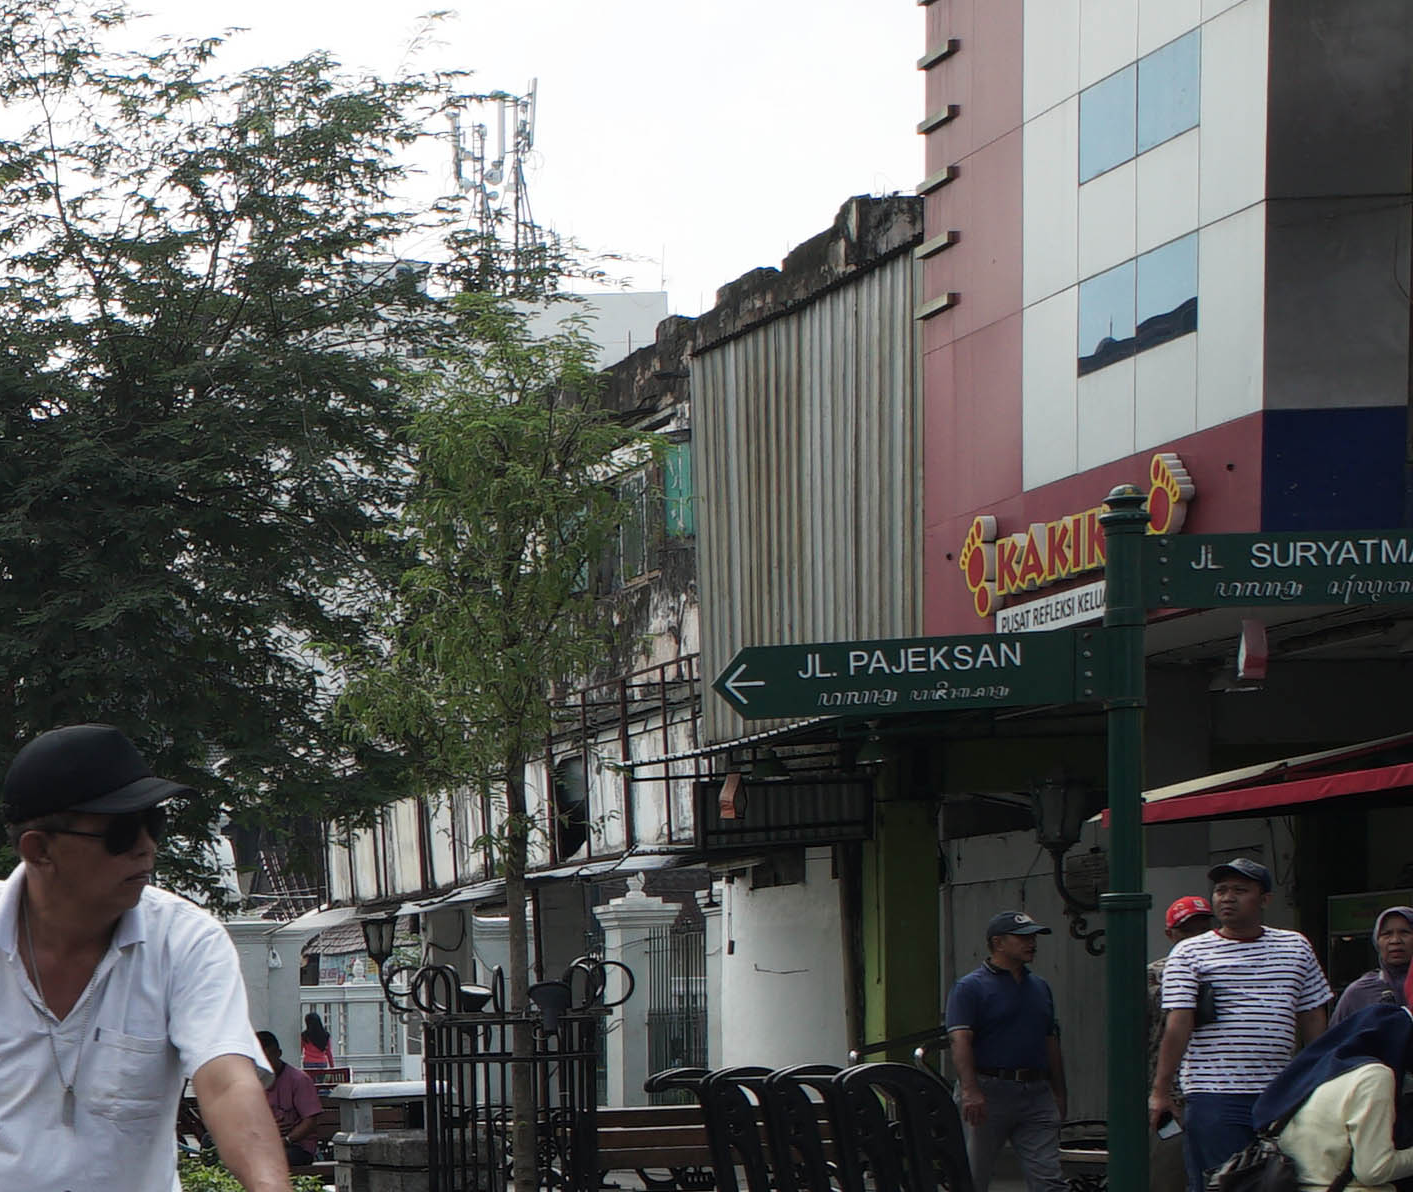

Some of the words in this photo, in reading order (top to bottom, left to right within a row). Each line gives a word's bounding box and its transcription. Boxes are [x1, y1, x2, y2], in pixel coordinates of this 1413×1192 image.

[995, 504, 1113, 596] KAKIK
[1251, 538, 1413, 569] SURYATM
[1001, 608, 1031, 634] PUSAT
[1032, 596, 1076, 626] REFLEKSI
[797, 654, 838, 679] JL.
[849, 642, 1022, 676] PAJEKSAN
